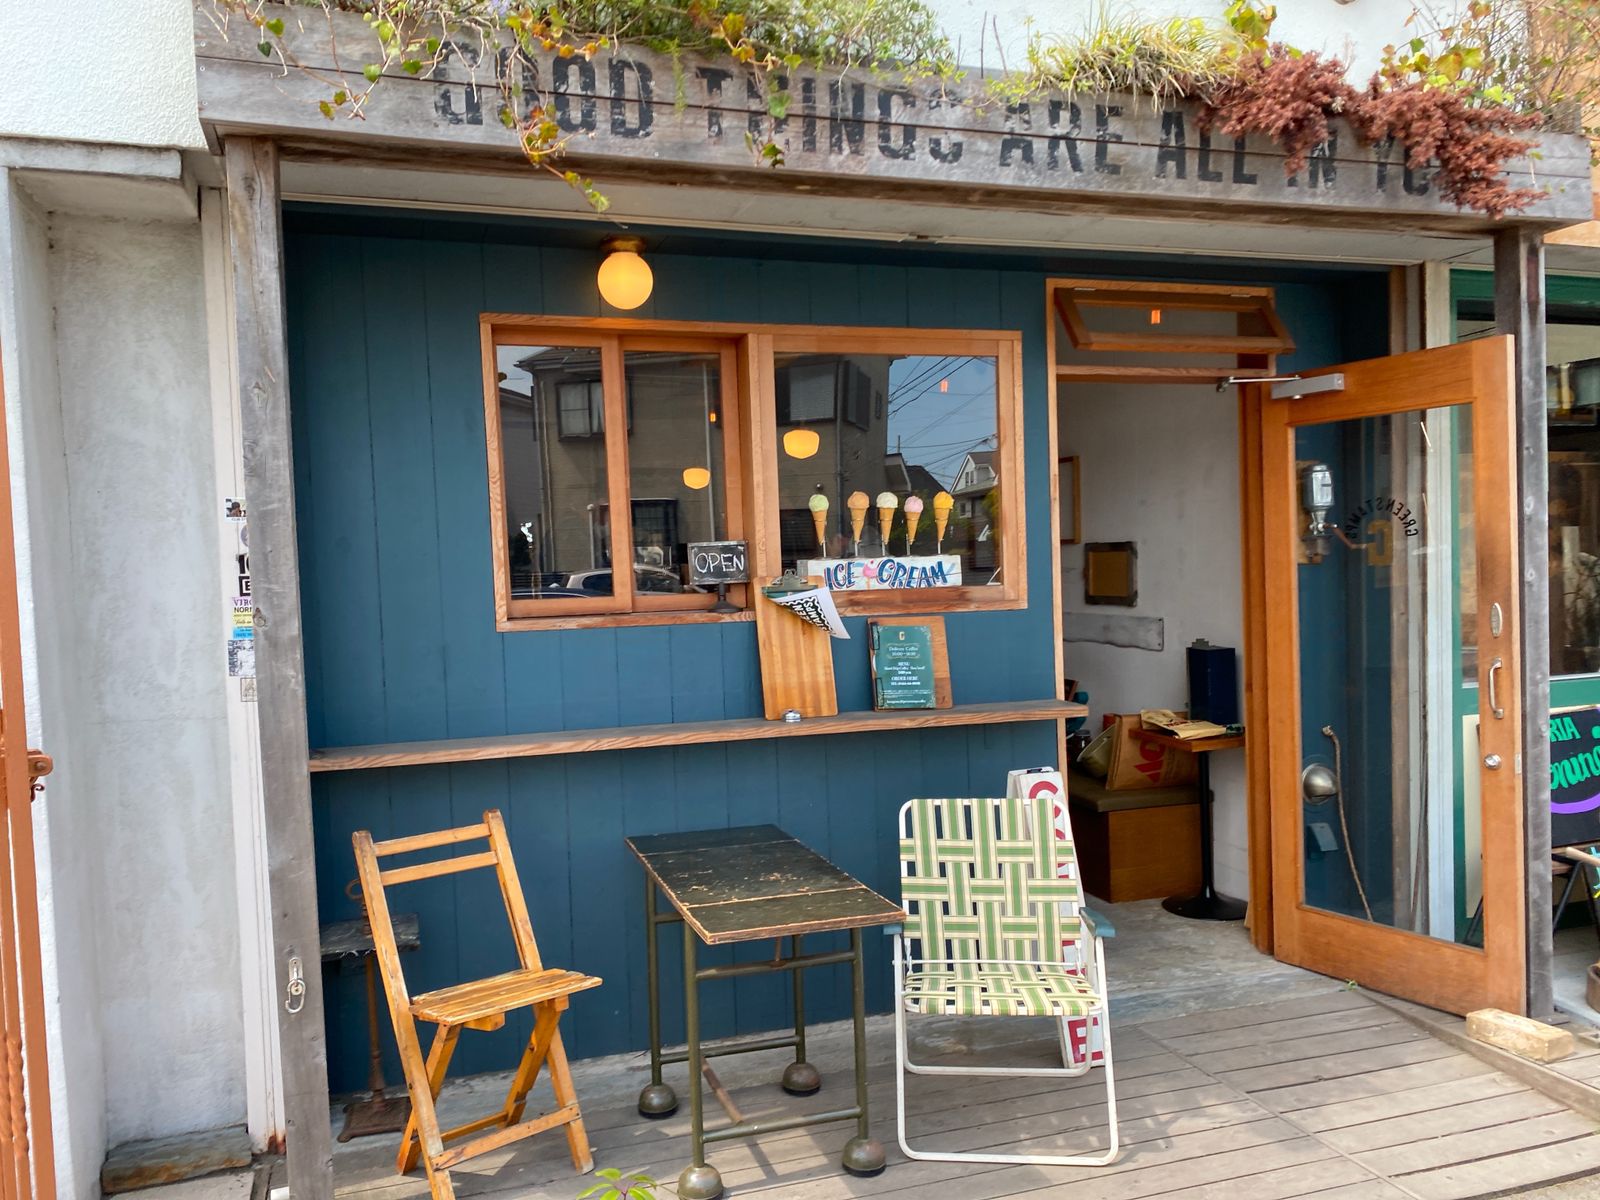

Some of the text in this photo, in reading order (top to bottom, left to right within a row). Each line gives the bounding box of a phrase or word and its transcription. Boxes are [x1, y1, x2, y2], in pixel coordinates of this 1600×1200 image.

[999, 99, 1123, 175] ARE
[695, 552, 745, 573] OPEN
[824, 558, 948, 590] ICE CREAM
